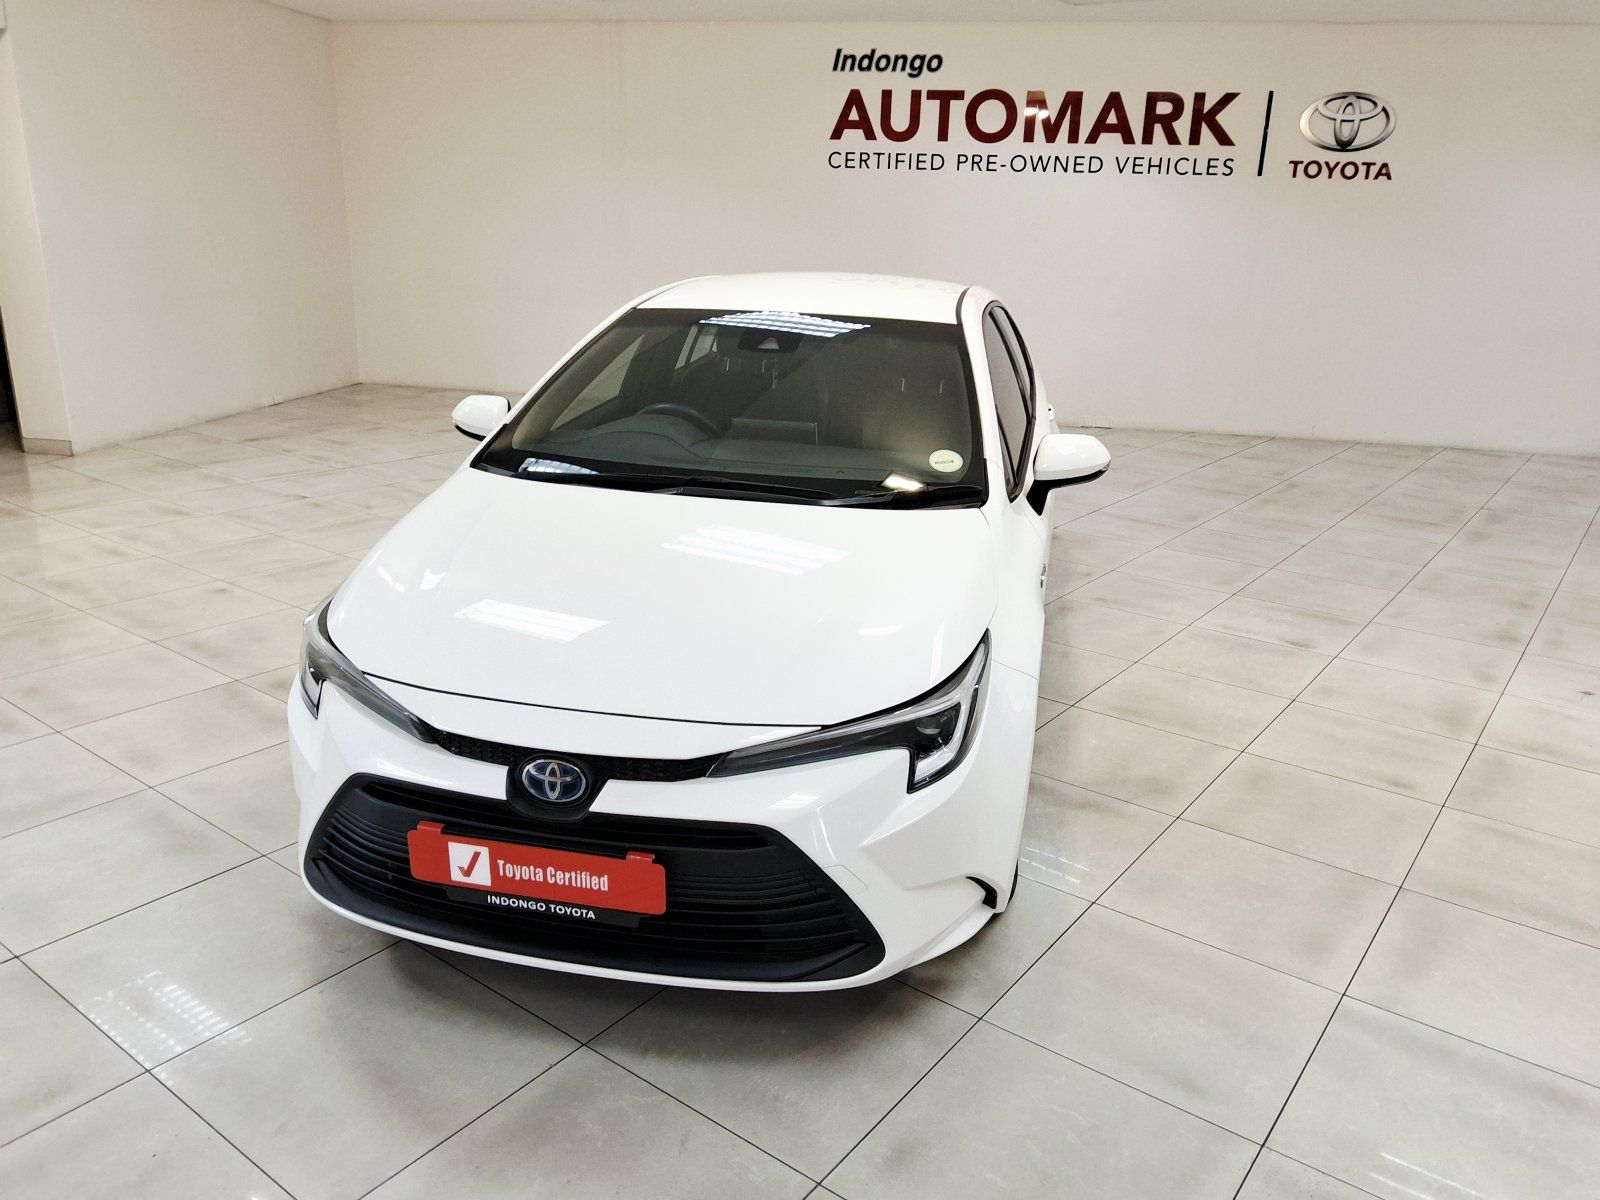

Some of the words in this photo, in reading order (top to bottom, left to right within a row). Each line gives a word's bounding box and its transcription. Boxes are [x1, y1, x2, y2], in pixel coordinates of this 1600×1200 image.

[832, 48, 944, 78] Indongo
[829, 88, 1242, 147] AUTOMARK
[828, 151, 946, 171] CERTIFIED
[956, 154, 1105, 173] PRE-OWNED
[1115, 156, 1235, 176] VEHICLES
[1288, 160, 1393, 181] TOYOTA
[497, 859, 544, 882] Toyota
[546, 866, 609, 892] Certified
[487, 894, 546, 911] INDONGO
[549, 903, 596, 920] TOYOTA
